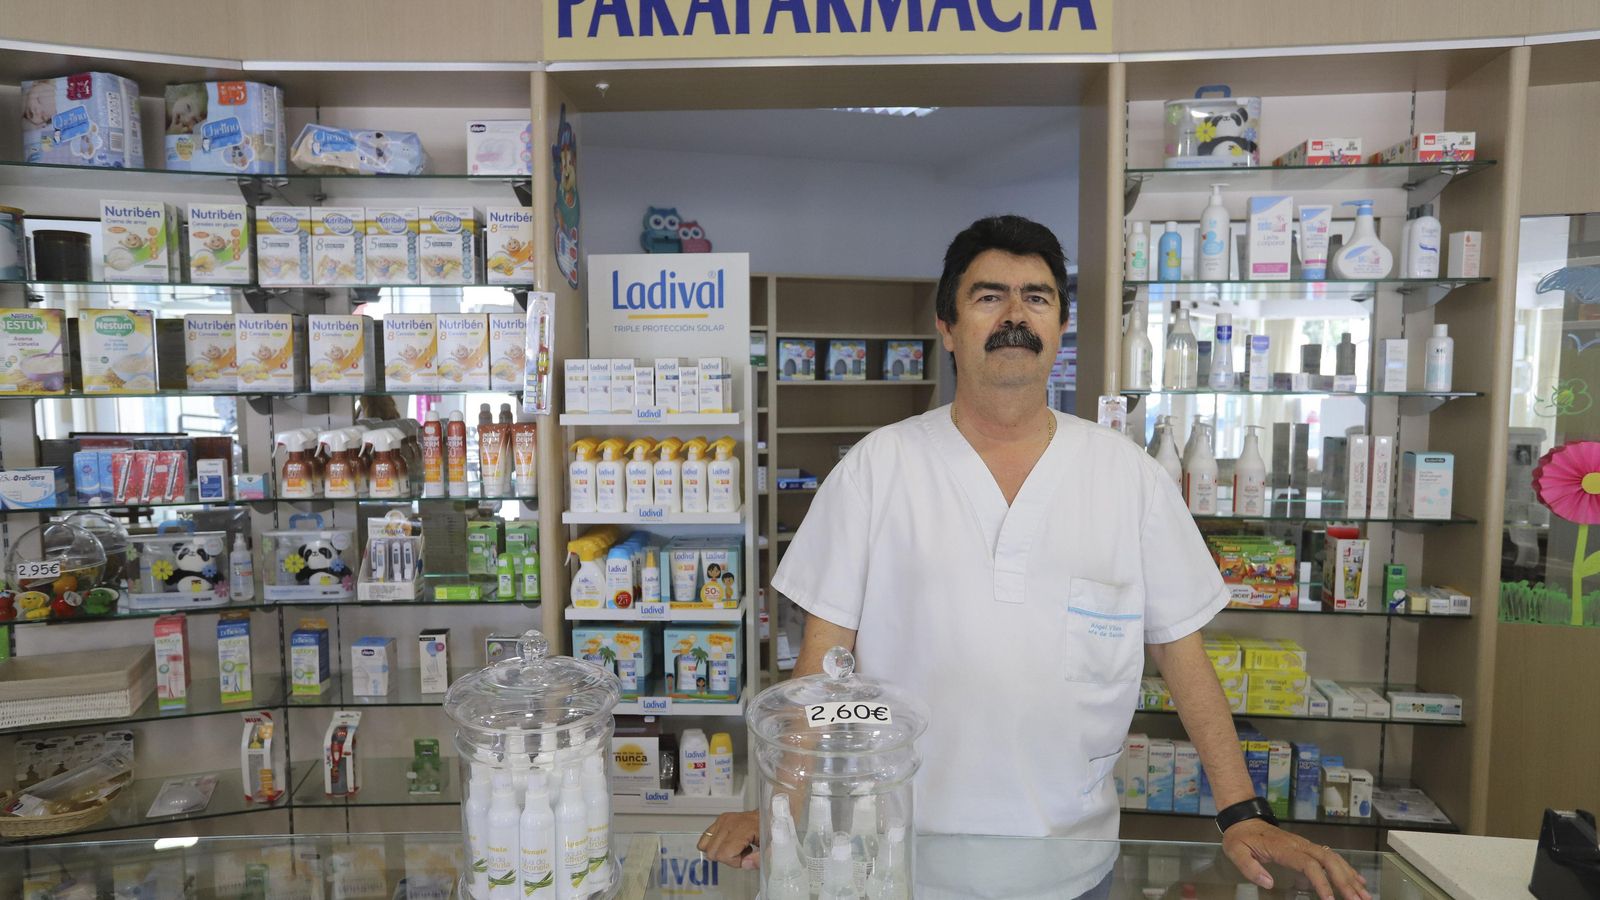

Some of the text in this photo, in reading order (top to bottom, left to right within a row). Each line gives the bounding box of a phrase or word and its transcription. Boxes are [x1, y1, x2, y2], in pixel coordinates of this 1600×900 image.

[105, 206, 160, 218] Nutribén
[192, 209, 242, 220] Nutribén
[612, 269, 724, 310] Ladival
[96, 321, 133, 330] Nestum
[188, 320, 236, 330] Nutribén
[239, 319, 288, 330] Nutribén
[312, 321, 359, 331] Nutribén
[386, 320, 432, 331] Nutribén
[439, 320, 484, 330] Nutribén
[614, 324, 725, 333] TRIPLE PROTECCIÓN SOLAR
[637, 408, 662, 418] Ladival
[639, 508, 663, 518] Ladival
[674, 551, 695, 560] Ladival
[18, 563, 60, 577] 2,95€
[608, 565, 628, 573] Ladival
[641, 605, 665, 615] Ladival
[643, 700, 667, 709] Ladival
[810, 704, 888, 726] 2,60€
[685, 750, 706, 759] Ladival
[645, 792, 669, 801] Ladival
